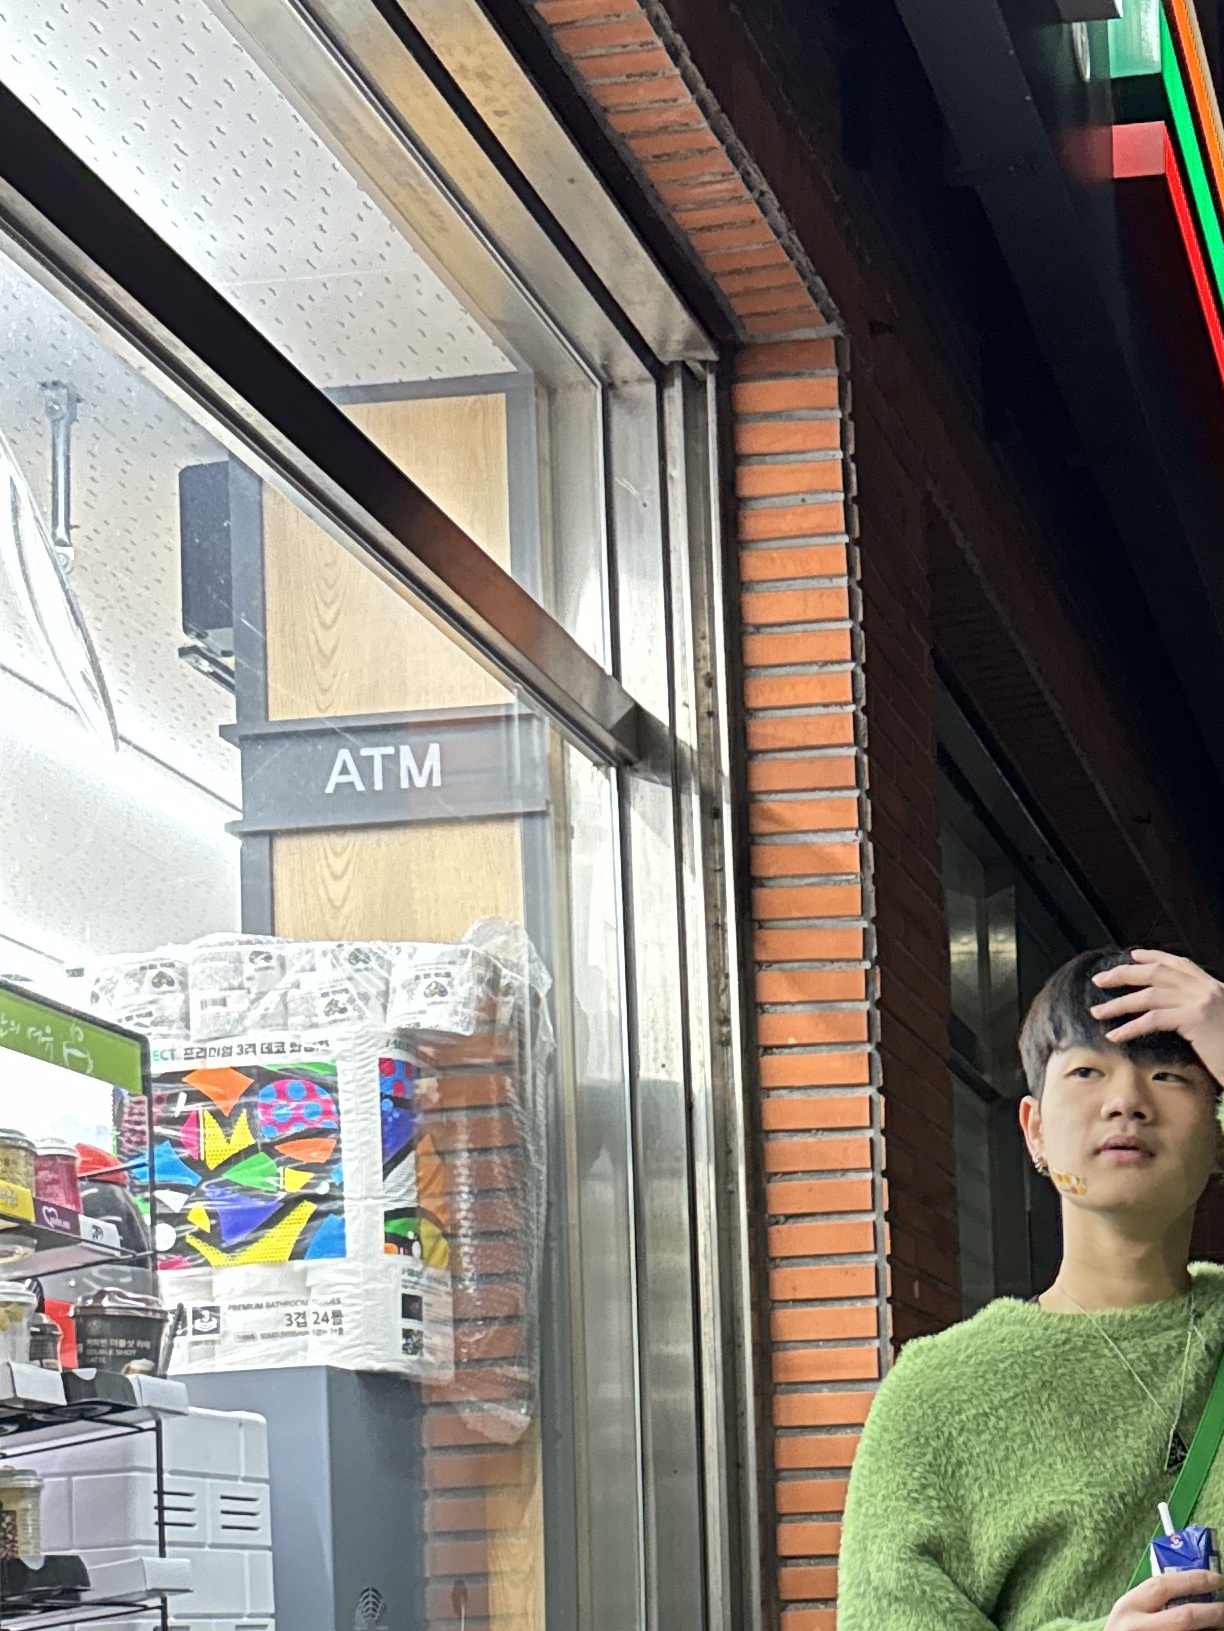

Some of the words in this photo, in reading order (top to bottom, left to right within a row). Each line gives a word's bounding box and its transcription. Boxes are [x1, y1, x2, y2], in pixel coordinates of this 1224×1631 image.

[325, 743, 442, 794] ATM
[183, 1044, 233, 1061] 프리미엄
[260, 1041, 286, 1055] 데코
[285, 1311, 308, 1328] 3겹
